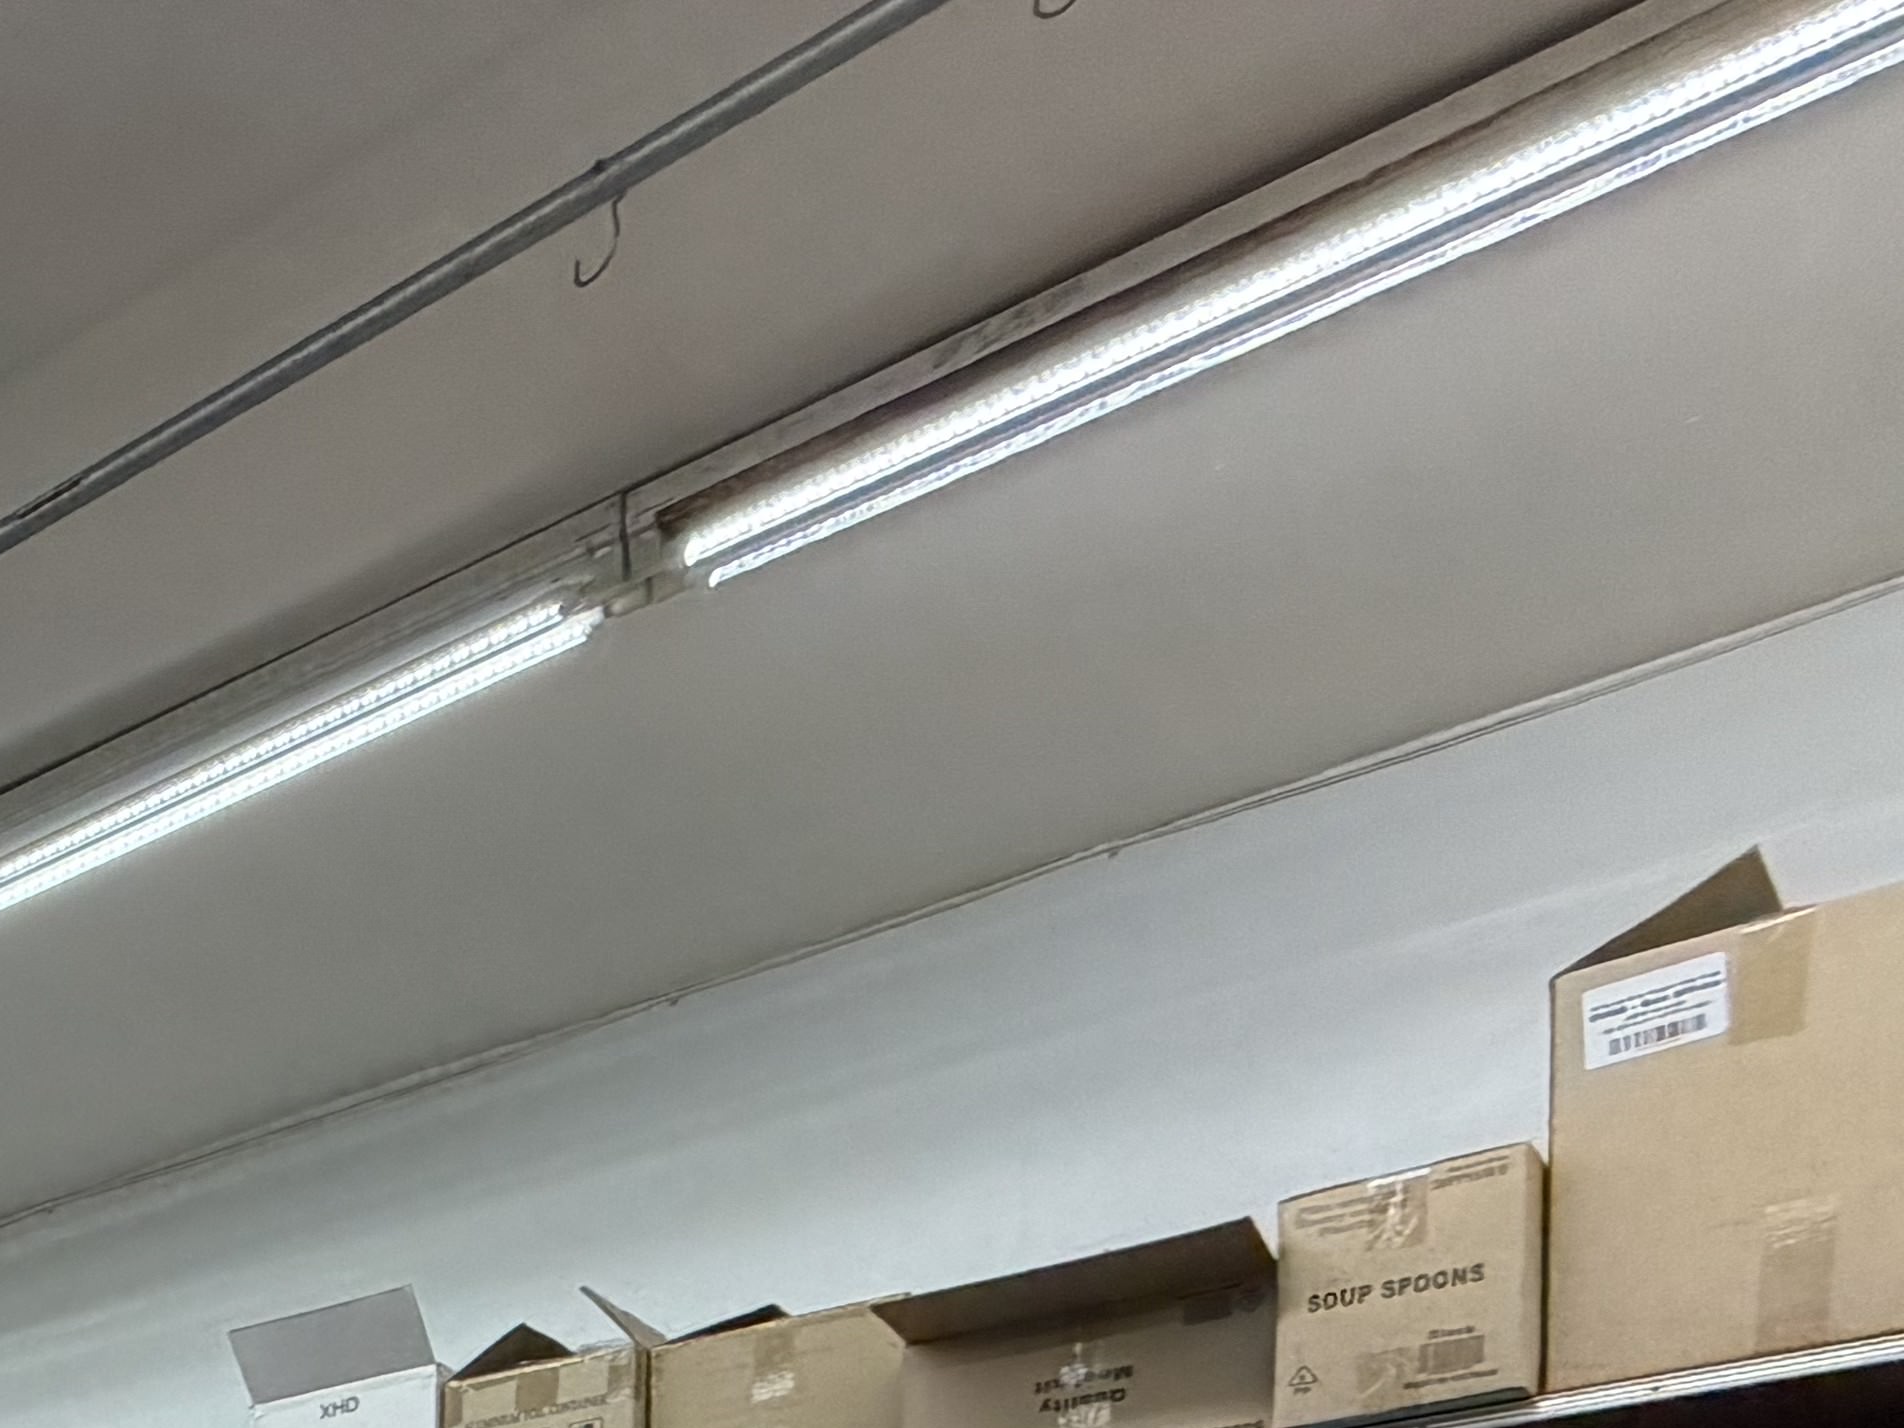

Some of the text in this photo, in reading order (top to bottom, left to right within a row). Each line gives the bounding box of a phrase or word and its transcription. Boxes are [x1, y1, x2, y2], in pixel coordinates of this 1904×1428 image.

[1307, 1262, 1486, 1314] SOUP SPOONS
[319, 1396, 360, 1419] XHD
